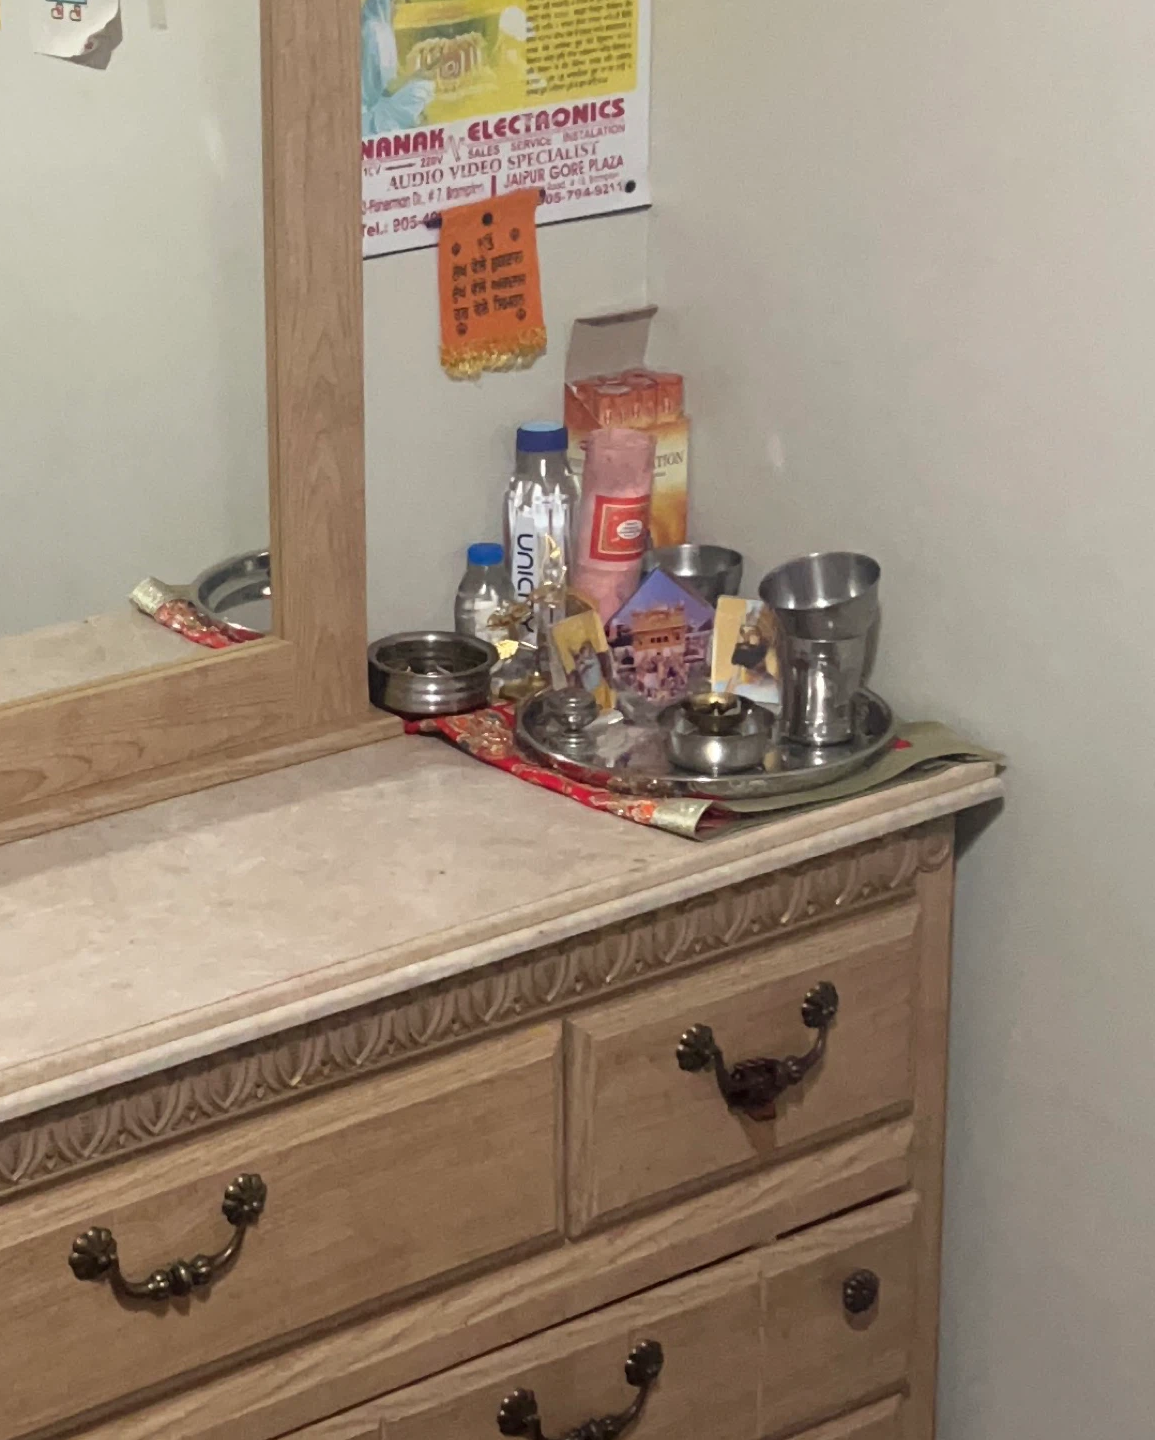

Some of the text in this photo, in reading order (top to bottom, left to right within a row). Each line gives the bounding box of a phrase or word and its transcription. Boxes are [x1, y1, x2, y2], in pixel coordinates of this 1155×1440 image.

[361, 97, 626, 161] NANAK ELECTRONICS
[467, 144, 501, 160] SALES
[511, 136, 552, 153] SERVICE
[387, 140, 600, 191] AUDIO VIDEO SPECIALIST
[503, 168, 546, 189] JAIPUR
[548, 160, 585, 180] GORE
[588, 154, 625, 173] PLAZA
